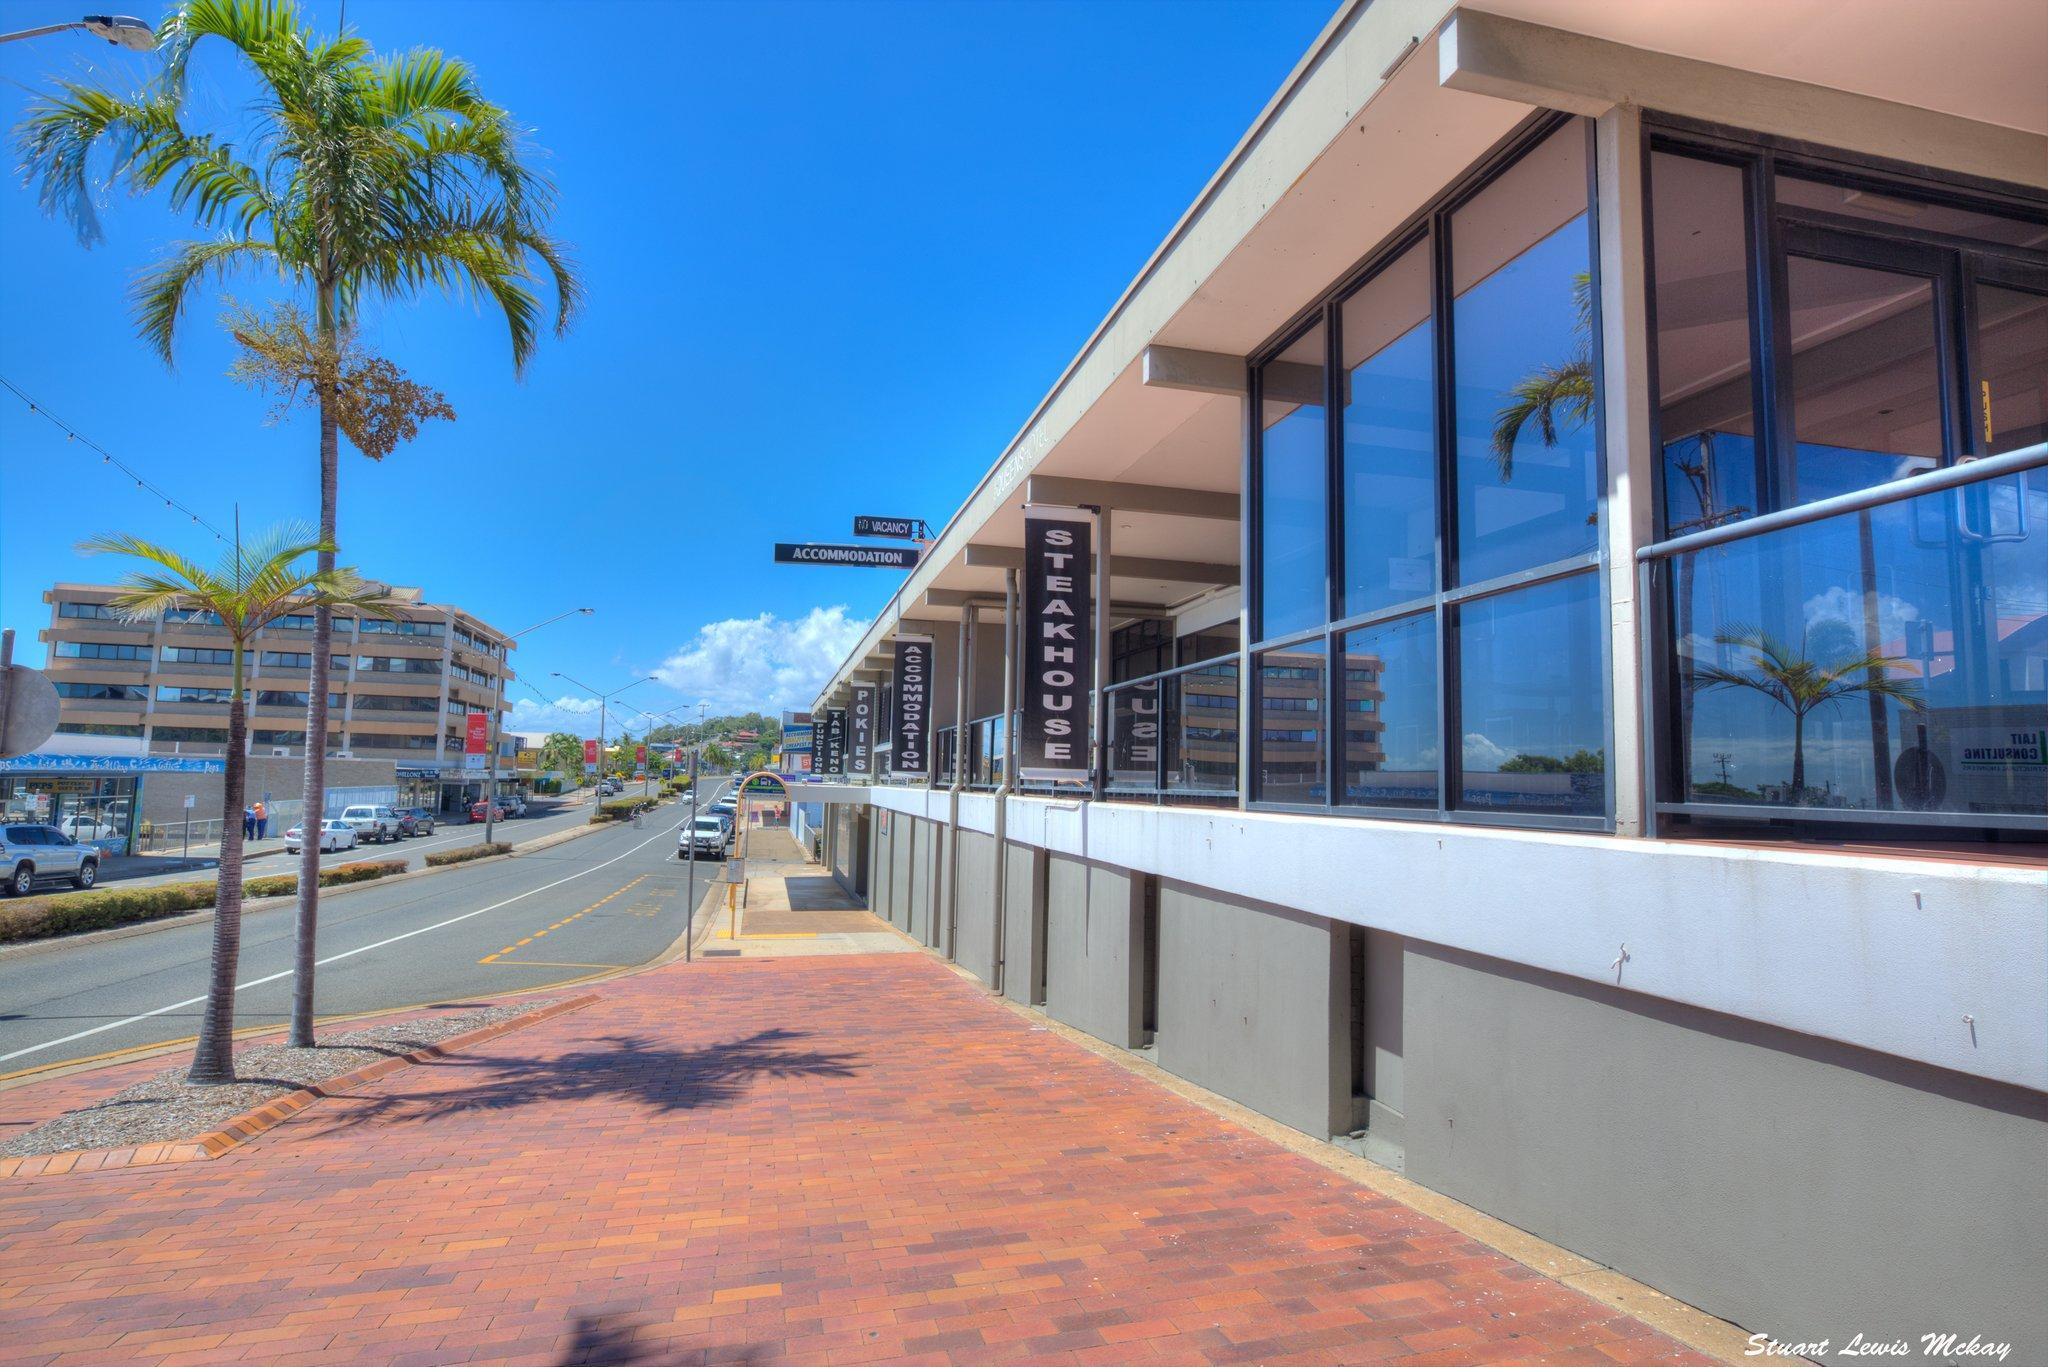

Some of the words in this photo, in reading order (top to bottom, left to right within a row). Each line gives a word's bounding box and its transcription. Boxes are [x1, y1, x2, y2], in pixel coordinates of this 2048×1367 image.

[792, 547, 903, 564] ACCOMMODATION
[871, 520, 909, 534] VACANCY
[1041, 529, 1075, 760] STEAKHOUSE
[854, 690, 869, 771] POKIES
[901, 645, 923, 769] ACCOMMODATION
[815, 724, 824, 773] FUNCTIONS
